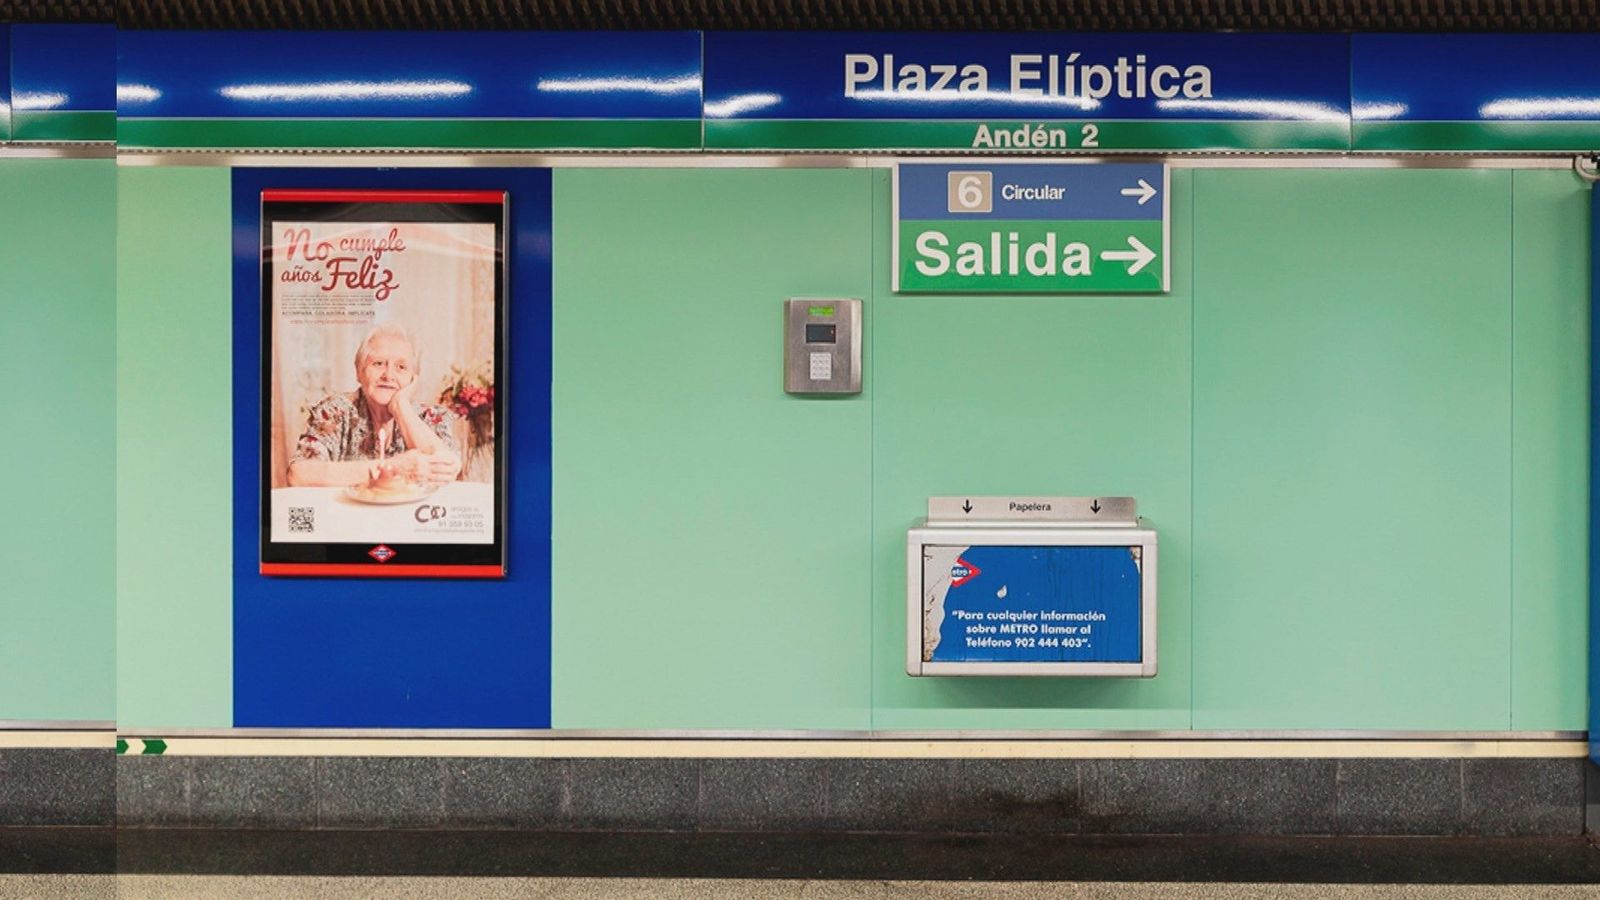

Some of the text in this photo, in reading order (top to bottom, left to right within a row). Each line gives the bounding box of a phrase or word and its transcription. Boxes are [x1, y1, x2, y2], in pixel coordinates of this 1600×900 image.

[845, 52, 1213, 109] Plaza Elíptica
[971, 123, 1099, 148] Andén 2
[958, 176, 1066, 208] 6 Circular
[284, 228, 406, 261] No cumple
[914, 230, 1092, 277] Salida
[281, 255, 399, 301] años Feliz
[1009, 502, 1052, 514] Papelera
[951, 567, 968, 577] etro
[966, 623, 1091, 634] sobre METRO llamar al
[986, 610, 1038, 622] cualquier
[965, 637, 1012, 648] Teléfono
[1014, 638, 1035, 648] 902
[1038, 638, 1058, 648] 444
